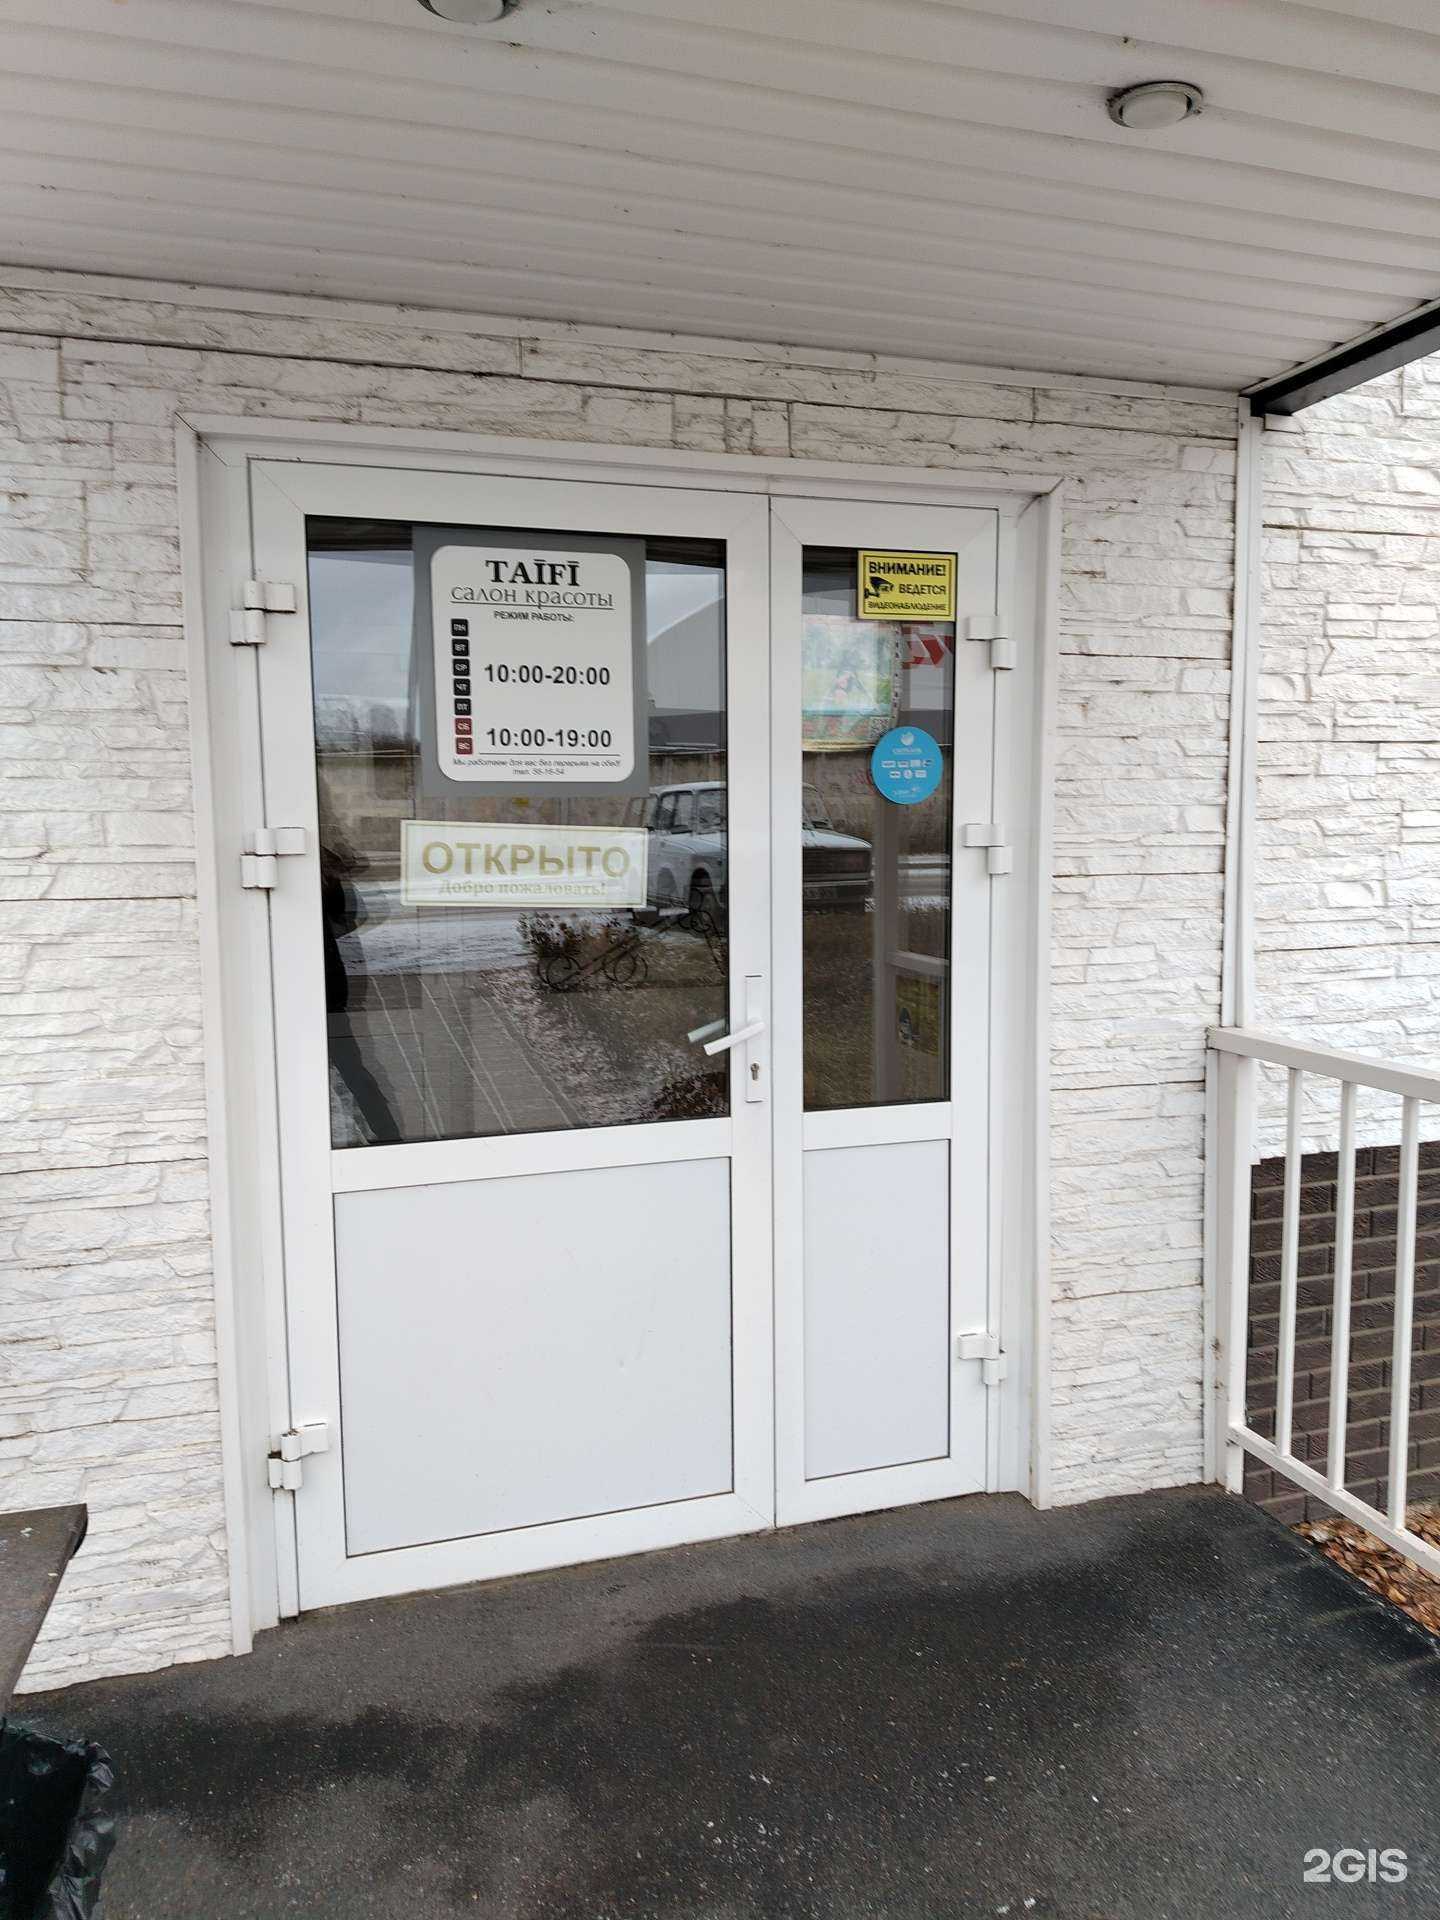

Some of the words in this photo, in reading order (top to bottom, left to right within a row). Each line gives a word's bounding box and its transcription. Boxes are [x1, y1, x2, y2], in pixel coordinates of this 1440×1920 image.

[868, 561, 946, 576] ВНИМАНИЕ!
[451, 586, 517, 602] салон
[526, 589, 613, 608] красоты
[899, 583, 947, 595] ВЕДЕТСЯ
[867, 601, 946, 611] ВИДЕОНАБЛЮДЕНИЕ
[494, 610, 530, 620] РЕЖИМ
[484, 664, 611, 685] 10:00-20:00
[486, 728, 612, 748] 10:00-19:00
[422, 841, 630, 878] ОТКРЫТО
[438, 880, 494, 896] Добро
[497, 882, 607, 896] пожаловать!
